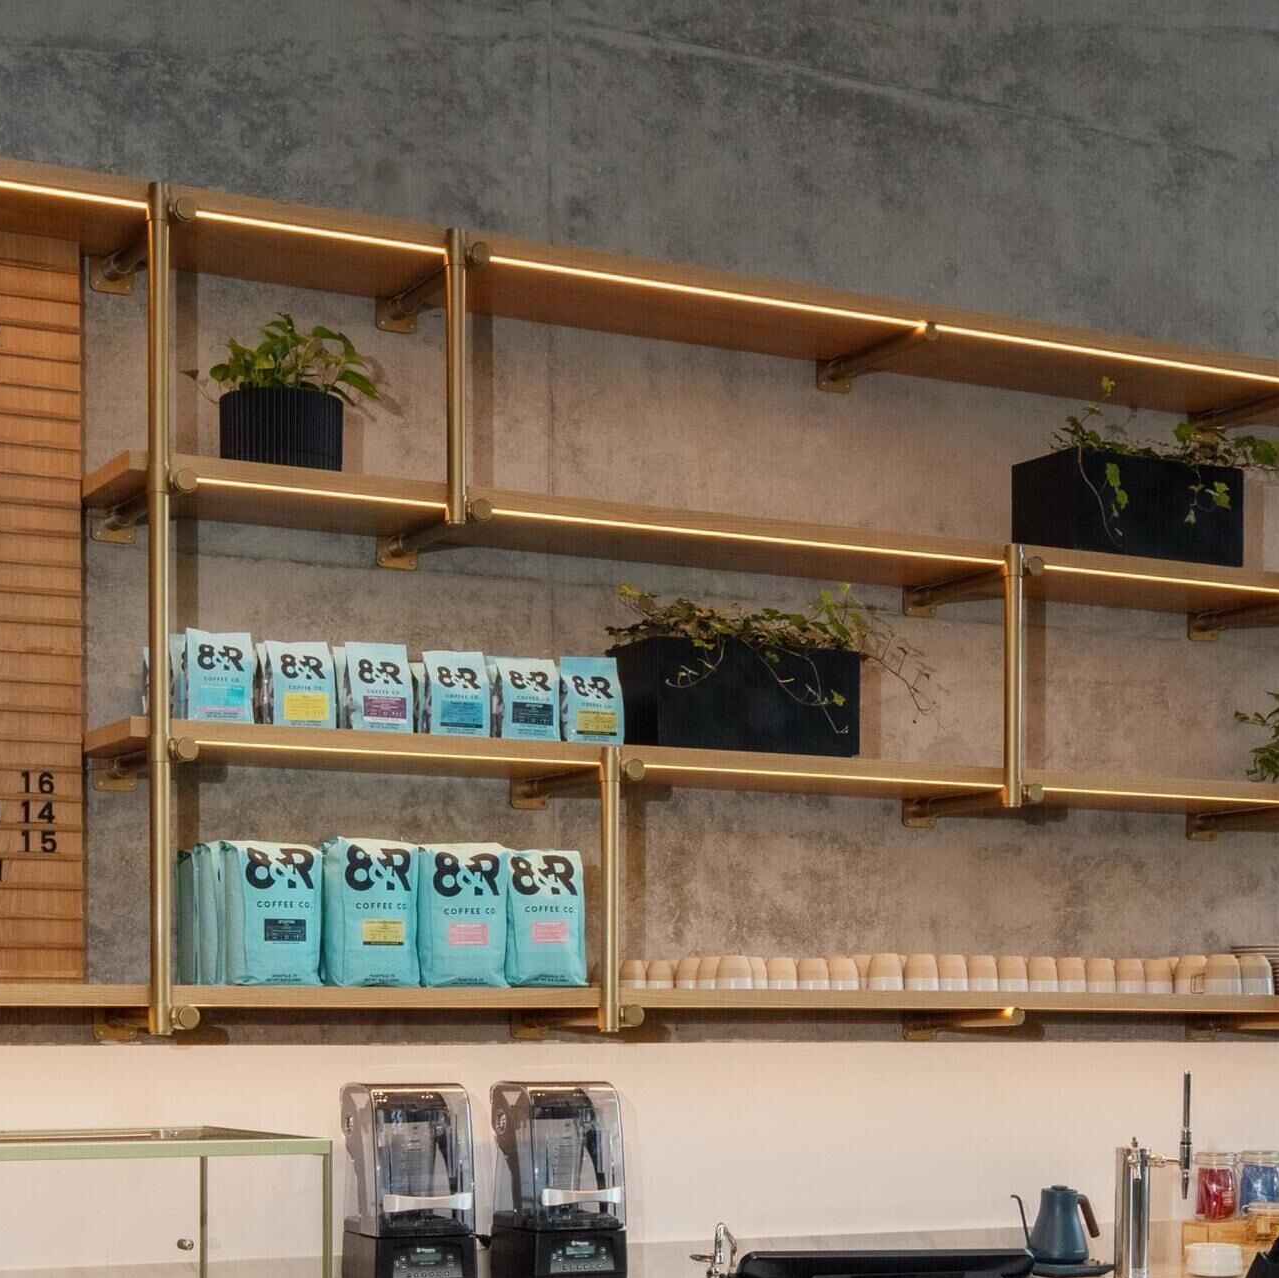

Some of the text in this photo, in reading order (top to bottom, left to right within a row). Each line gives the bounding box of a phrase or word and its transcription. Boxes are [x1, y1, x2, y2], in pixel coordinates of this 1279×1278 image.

[21, 771, 55, 794] 16
[21, 801, 55, 824] 14
[21, 831, 58, 853] 15
[245, 848, 314, 889] 8&R
[345, 844, 411, 892] 8&R
[433, 852, 500, 897] 8&R
[511, 855, 578, 896] 8&R
[356, 902, 392, 910] COFFEE
